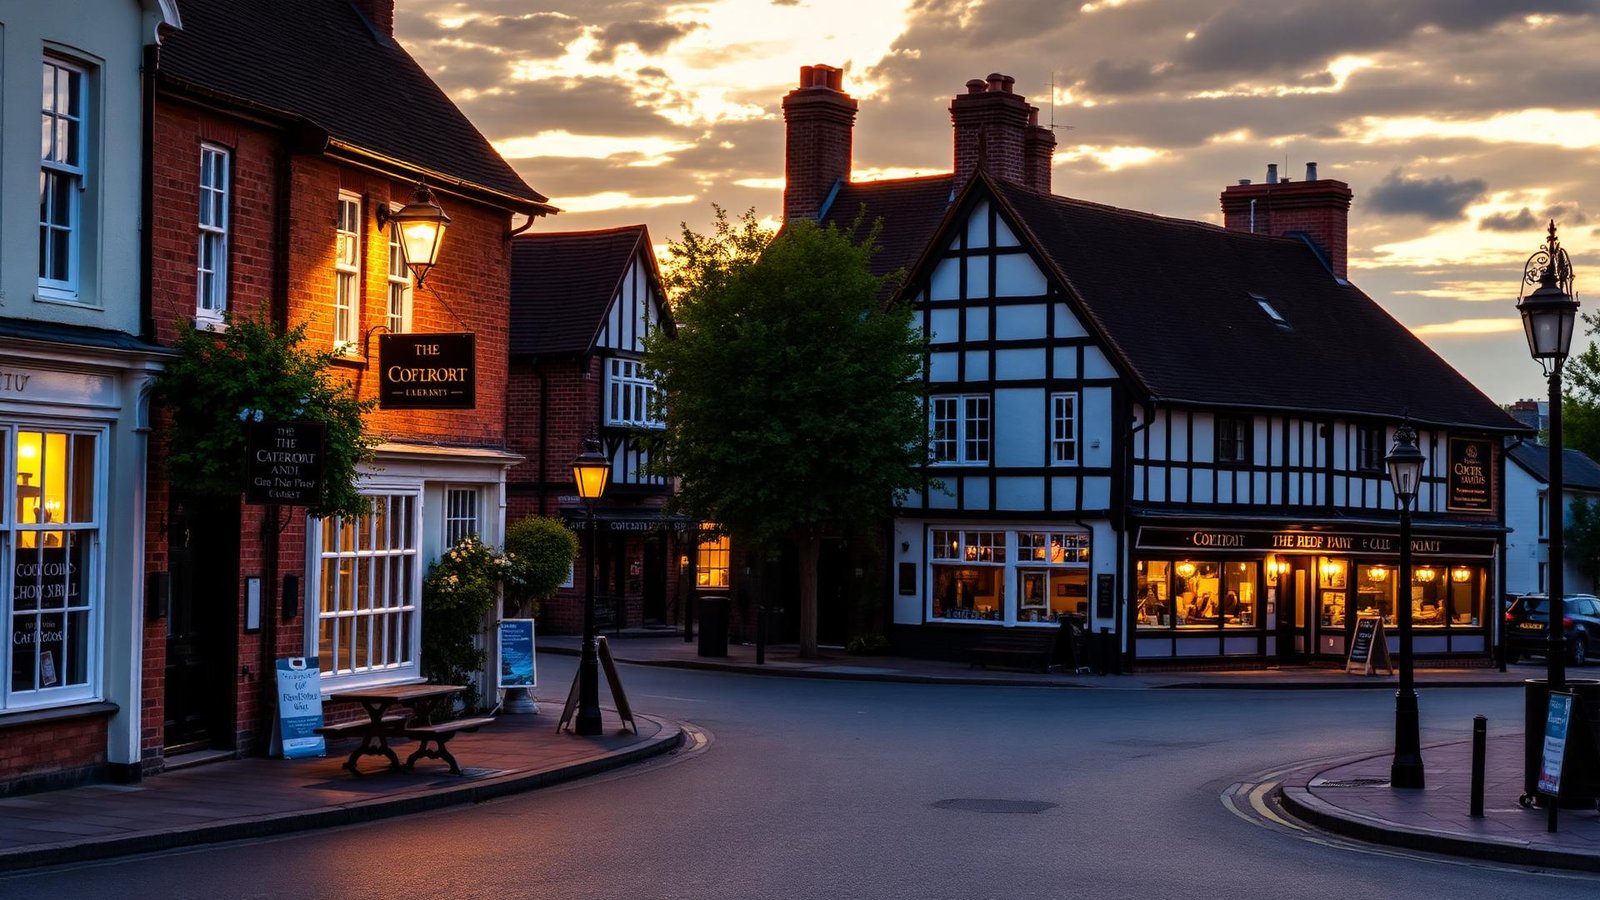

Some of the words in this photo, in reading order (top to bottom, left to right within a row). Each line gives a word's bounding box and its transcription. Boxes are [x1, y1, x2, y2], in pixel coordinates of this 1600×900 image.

[414, 344, 440, 356] THE
[275, 438, 297, 449] THE
[1272, 535, 1294, 547] THE
